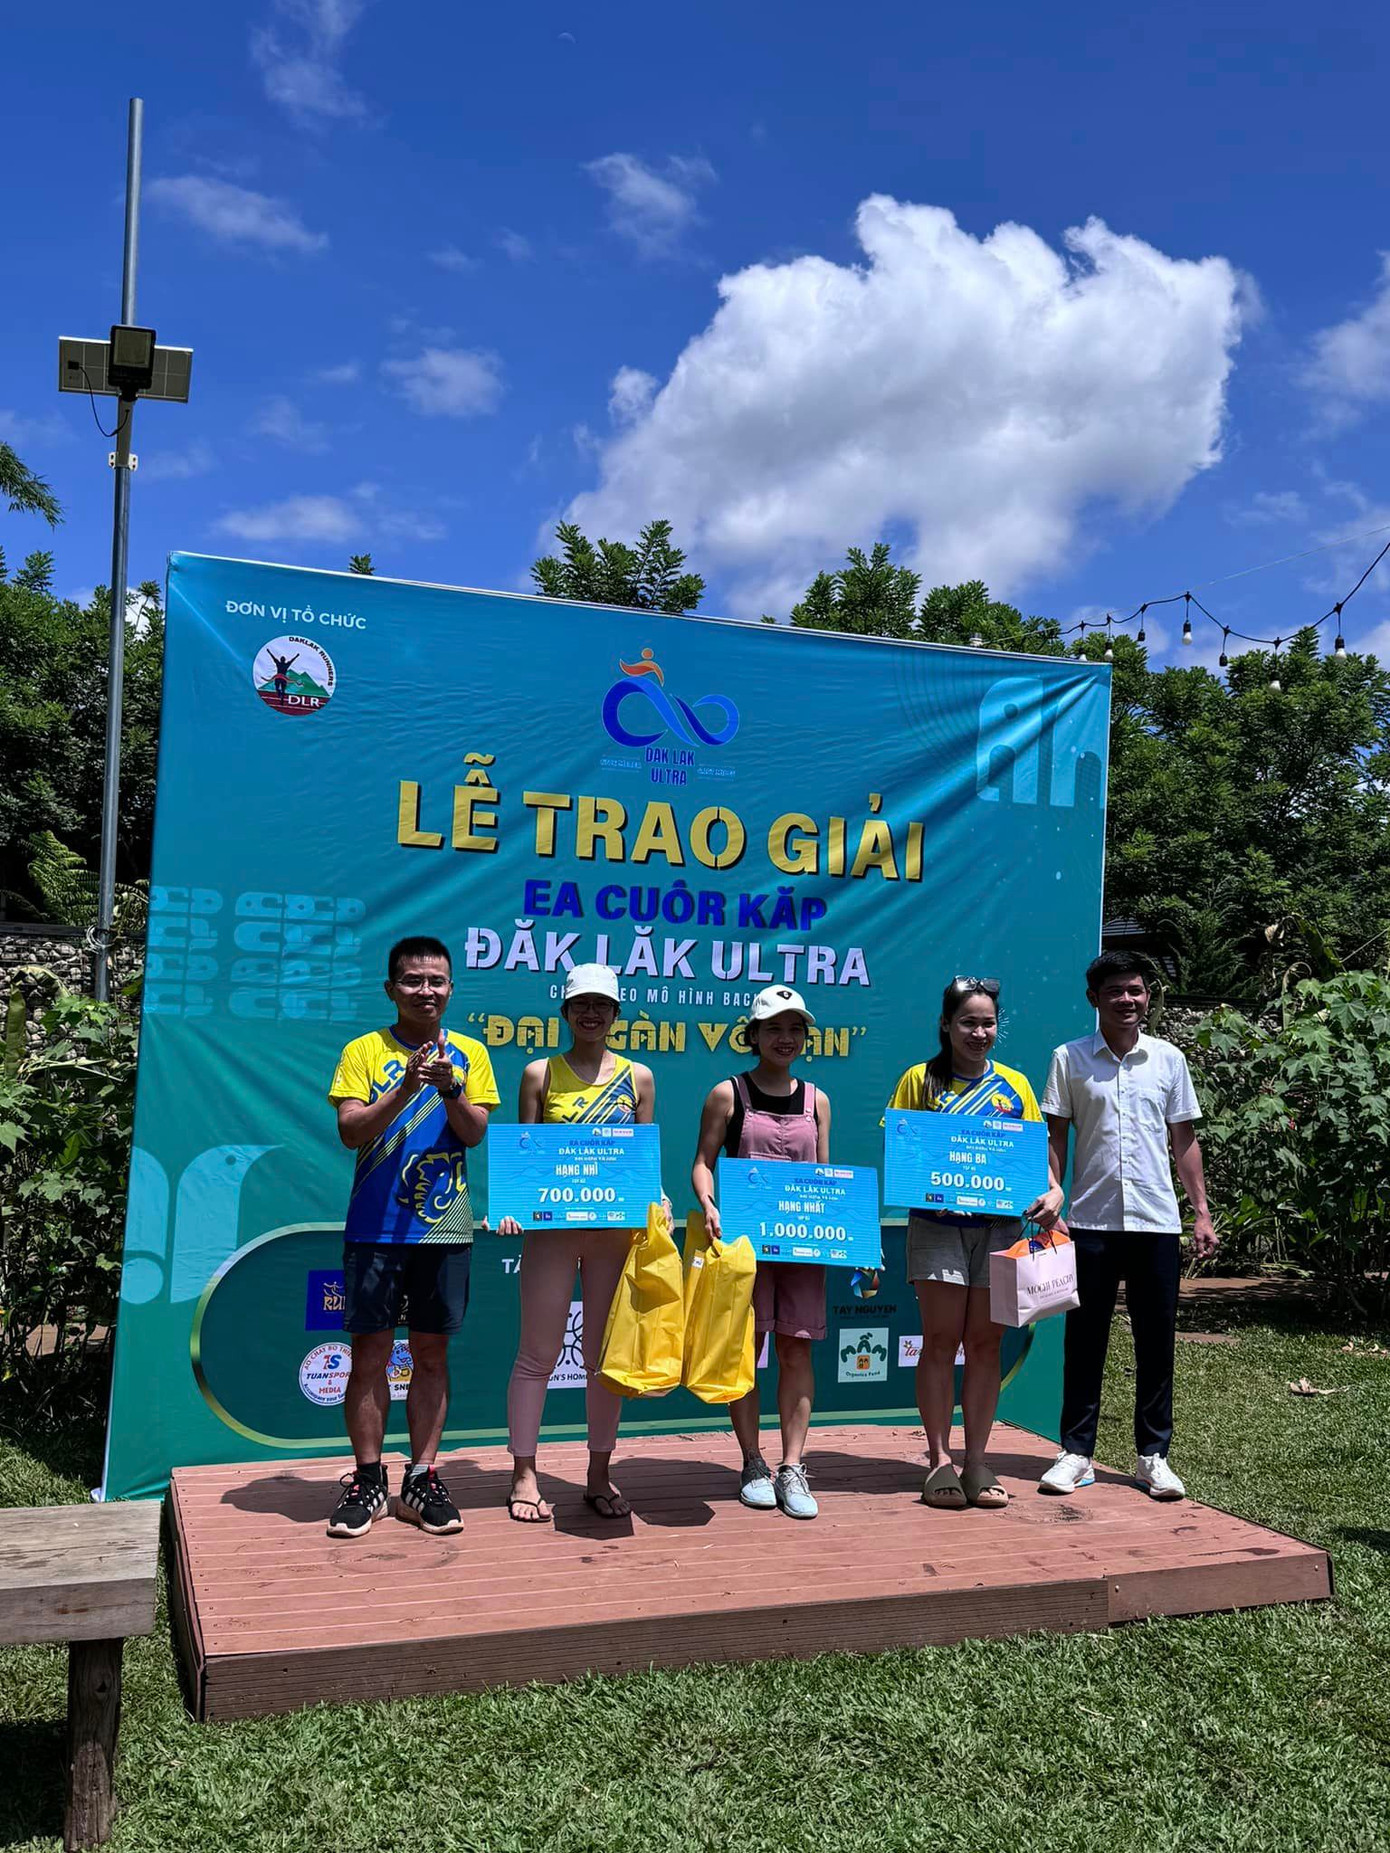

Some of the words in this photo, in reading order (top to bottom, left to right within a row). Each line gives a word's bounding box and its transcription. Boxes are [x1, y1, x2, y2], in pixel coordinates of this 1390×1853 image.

[225, 600, 265, 617] ĐƠN
[270, 606, 287, 623] VỊ
[292, 605, 315, 623] TỔ
[319, 613, 367, 629] CHỨC
[288, 695, 320, 707] DLR
[651, 767, 687, 786] ULTRA
[397, 752, 499, 852] LỄ
[522, 790, 747, 871] TRAO
[767, 792, 926, 881] GIẢI
[523, 879, 585, 918] EA
[594, 883, 727, 928] CUÔR
[738, 886, 828, 931] KĂP
[464, 918, 579, 973] ĐĂK
[594, 925, 698, 979] LĂK
[711, 939, 872, 987] ULTRA
[647, 986, 669, 1003] MÔ
[678, 988, 713, 1005] HÌNH
[605, 1009, 686, 1052] GÀN
[987, 1139, 1014, 1148] ULTRA
[949, 1151, 972, 1164] HẠNG
[974, 1153, 987, 1165] BA
[555, 1163, 580, 1178] HẠNG
[582, 1161, 599, 1176] NHÌ
[930, 1171, 1005, 1191] 500.000
[538, 1187, 616, 1203] 700.000
[820, 1188, 846, 1196] ULTRA
[778, 1201, 801, 1215] HẠNG
[803, 1199, 826, 1214] NHẤT
[759, 1221, 847, 1241] 1.000.000
